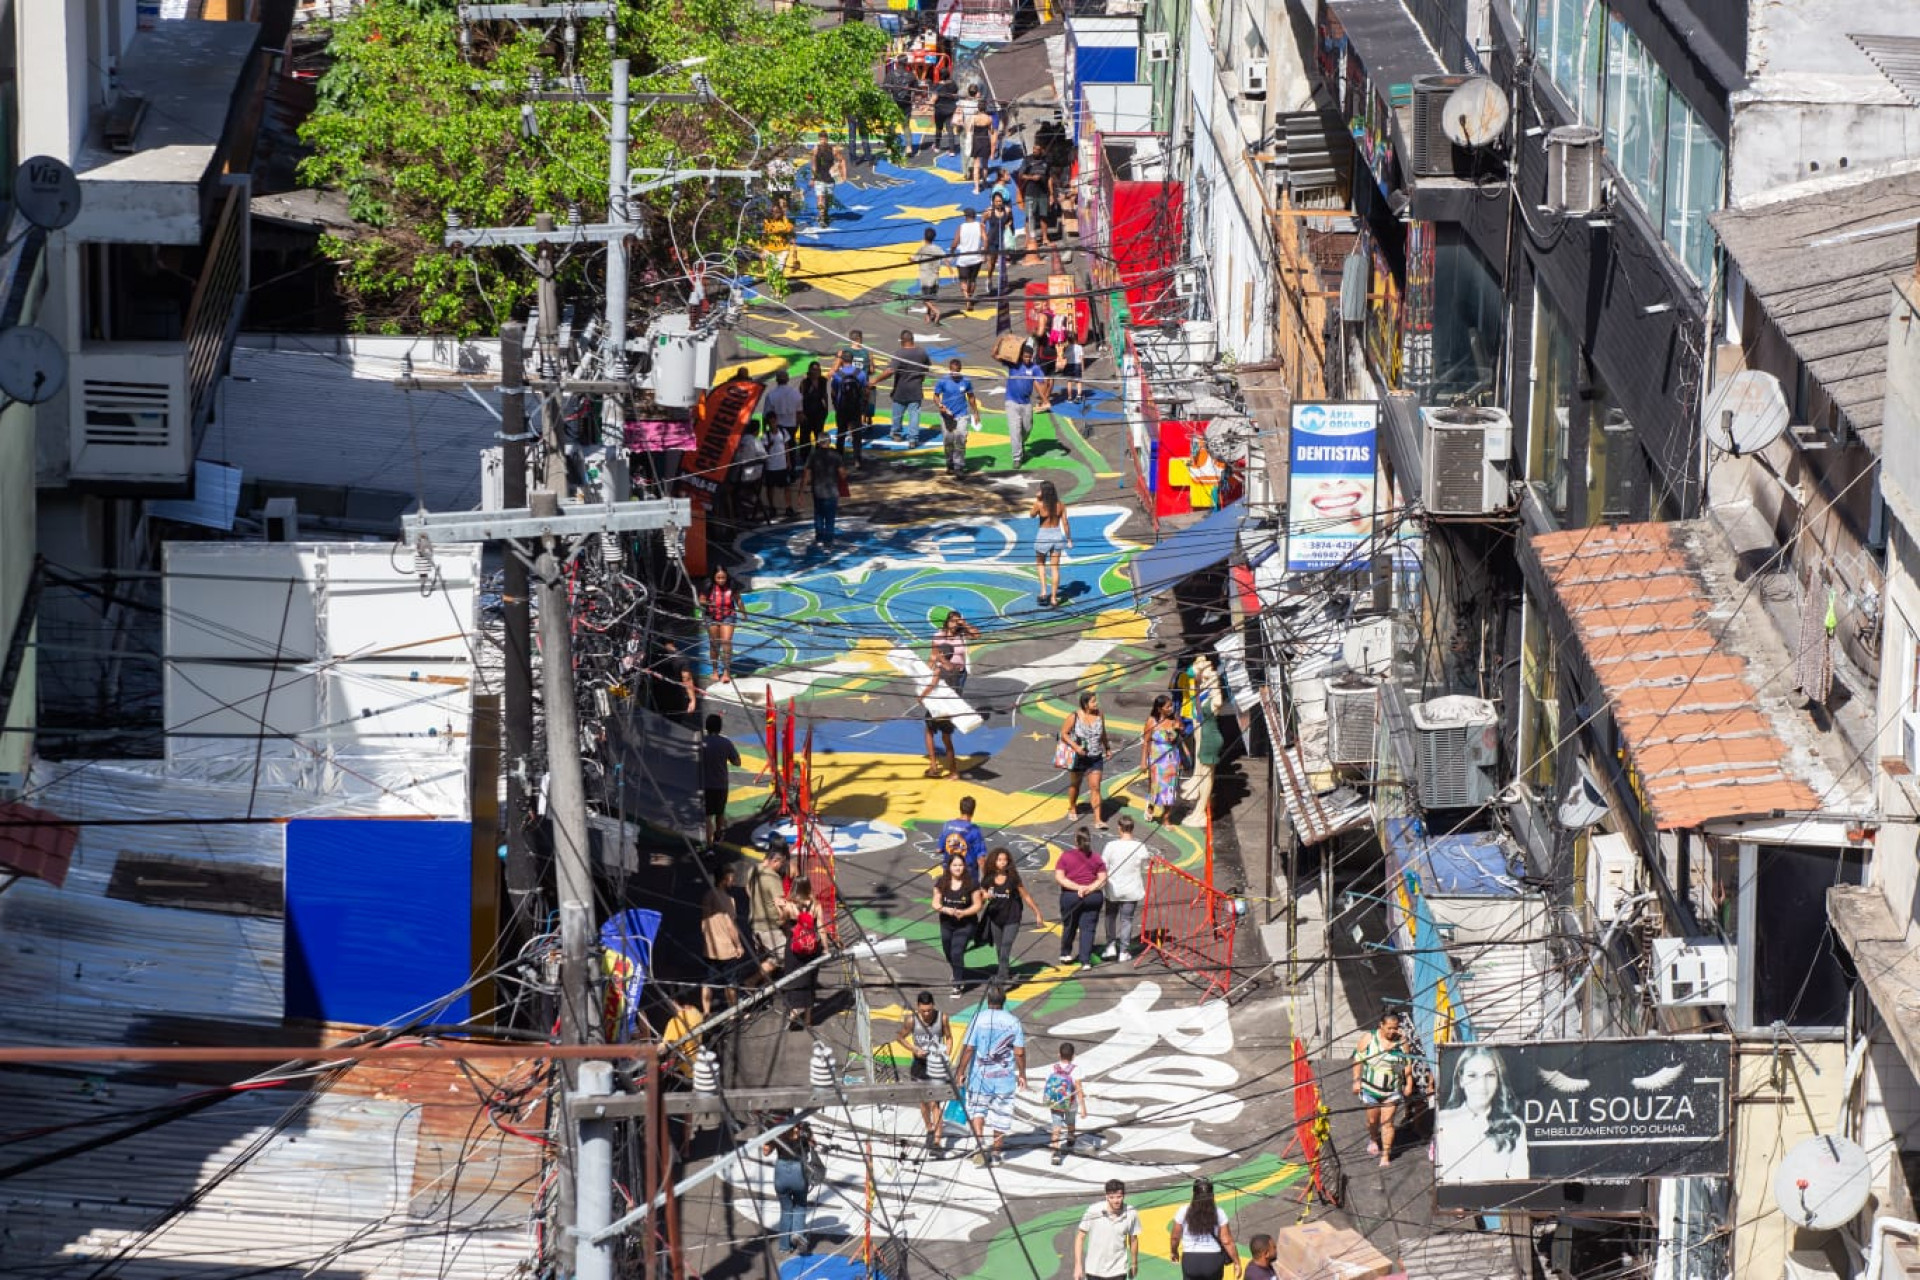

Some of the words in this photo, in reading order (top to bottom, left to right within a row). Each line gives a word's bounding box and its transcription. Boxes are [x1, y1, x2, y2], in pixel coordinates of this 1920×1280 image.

[30, 163, 61, 185] Via
[696, 384, 750, 471] CHAVEIRO
[1297, 445, 1370, 461] DENTISTAS
[1524, 1098, 1580, 1124] DAI
[1589, 1095, 1695, 1122] SOUZA
[1534, 1125, 1628, 1136] EMBELEZAMENTO
[1631, 1125, 1646, 1134] DO
[1649, 1123, 1686, 1133] OLHAR
